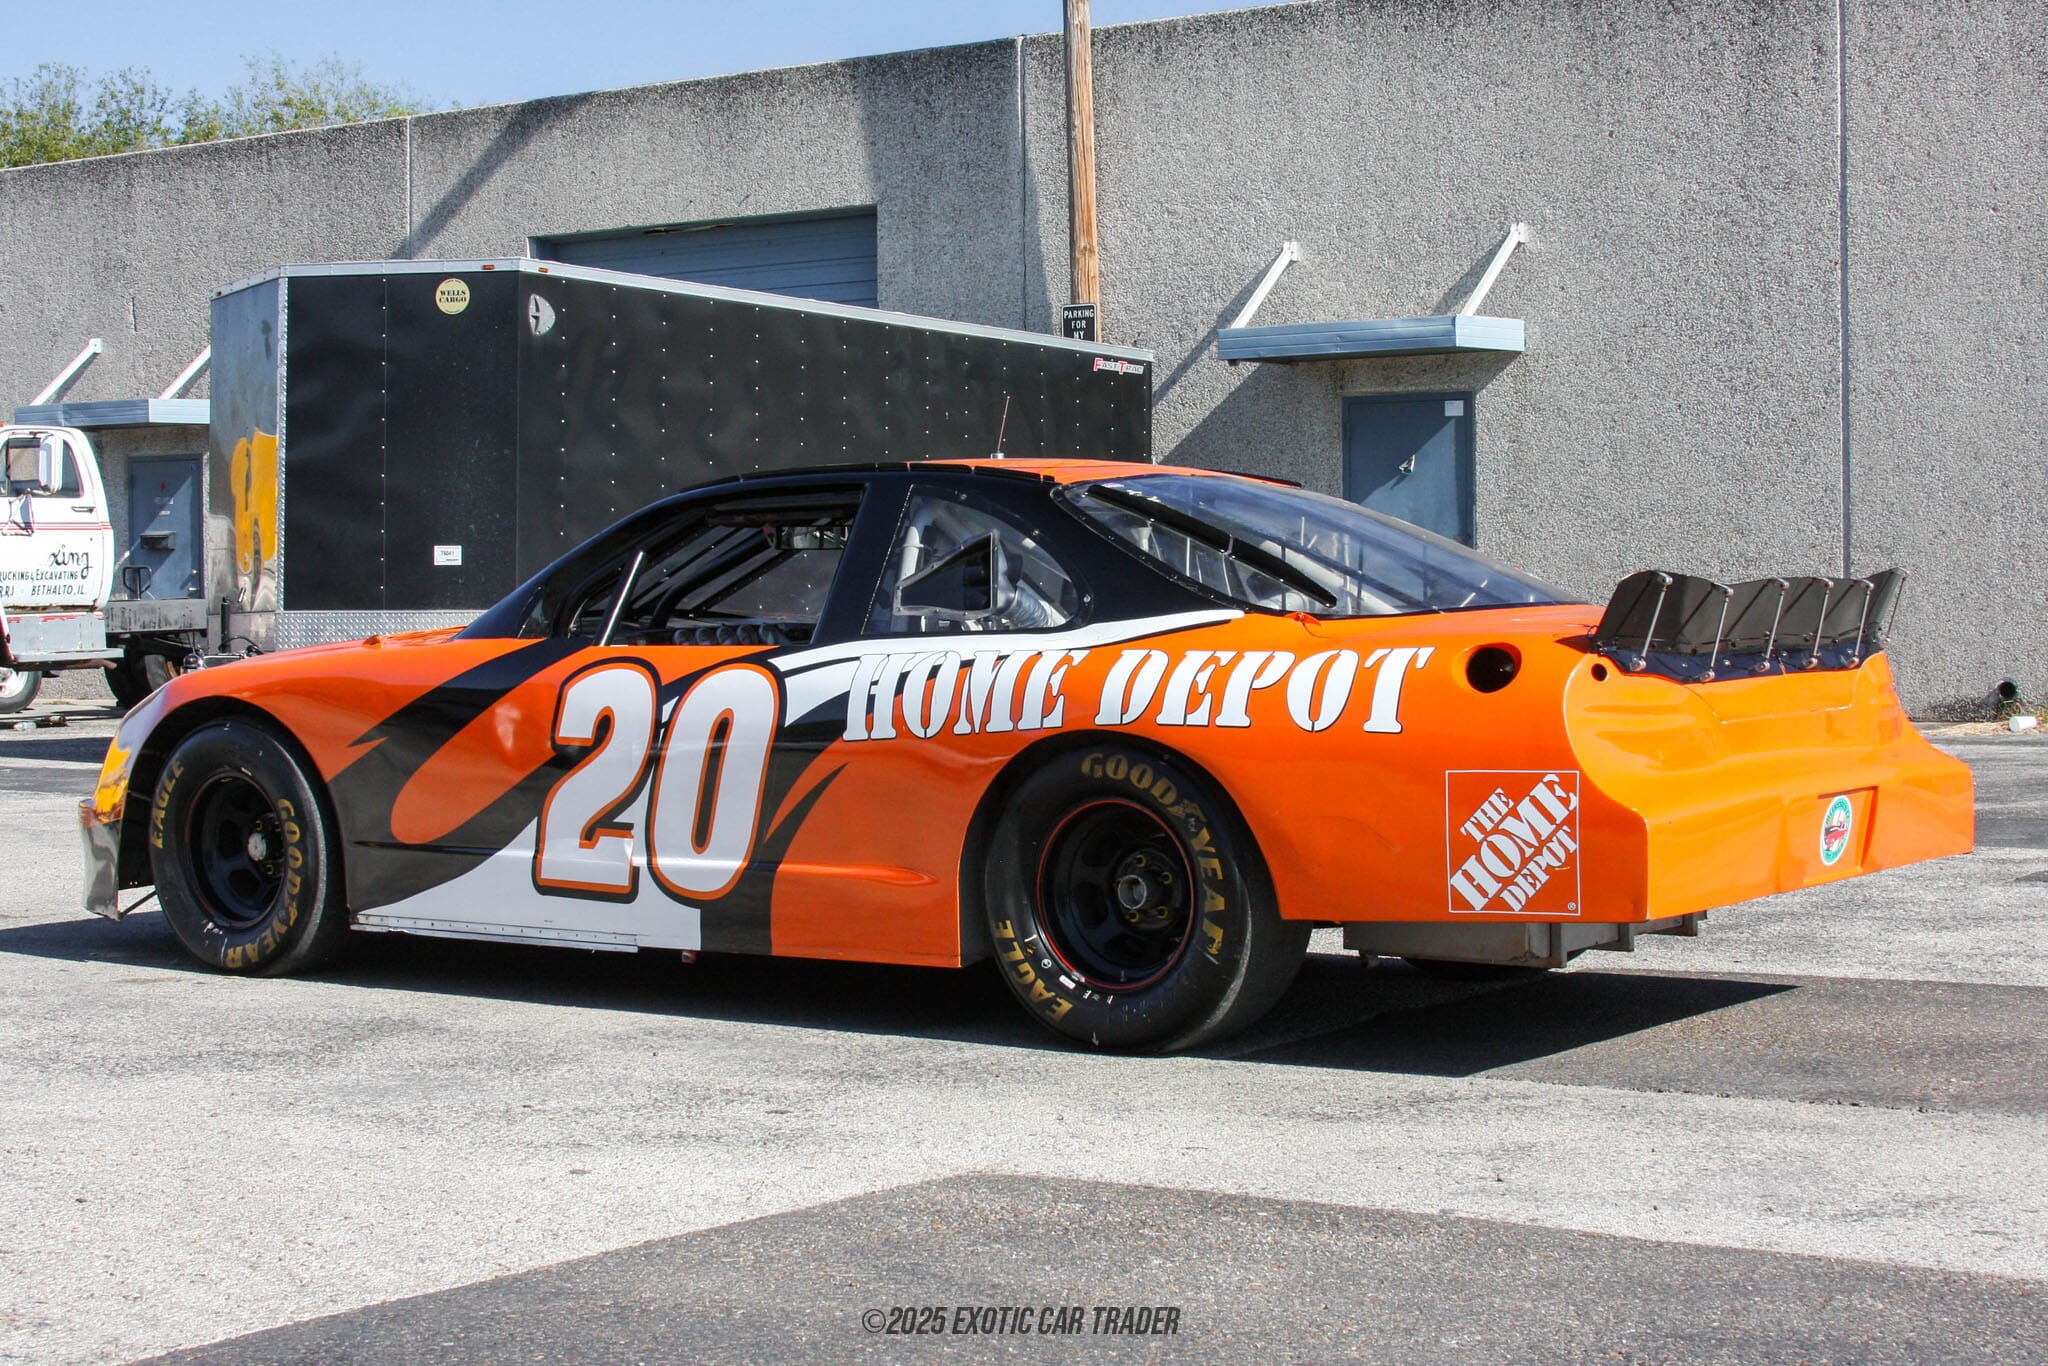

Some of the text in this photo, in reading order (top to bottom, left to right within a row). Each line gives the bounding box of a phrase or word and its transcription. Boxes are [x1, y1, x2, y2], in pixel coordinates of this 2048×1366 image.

[1063, 309, 1094, 319] PARKING
[1071, 320, 1086, 329] FOR
[1073, 331, 1085, 339] MY
[842, 646, 1436, 741] HOME DEPOT
[151, 760, 184, 849] EAGLE
[534, 658, 784, 904] 20
[1459, 787, 1514, 843] THE
[225, 798, 303, 969] GOODYEAR
[1081, 752, 1226, 956] GOODYEAR
[1450, 773, 1577, 911] HOME
[1499, 825, 1577, 912] DEPOT
[993, 919, 1073, 1022] EAGLE
